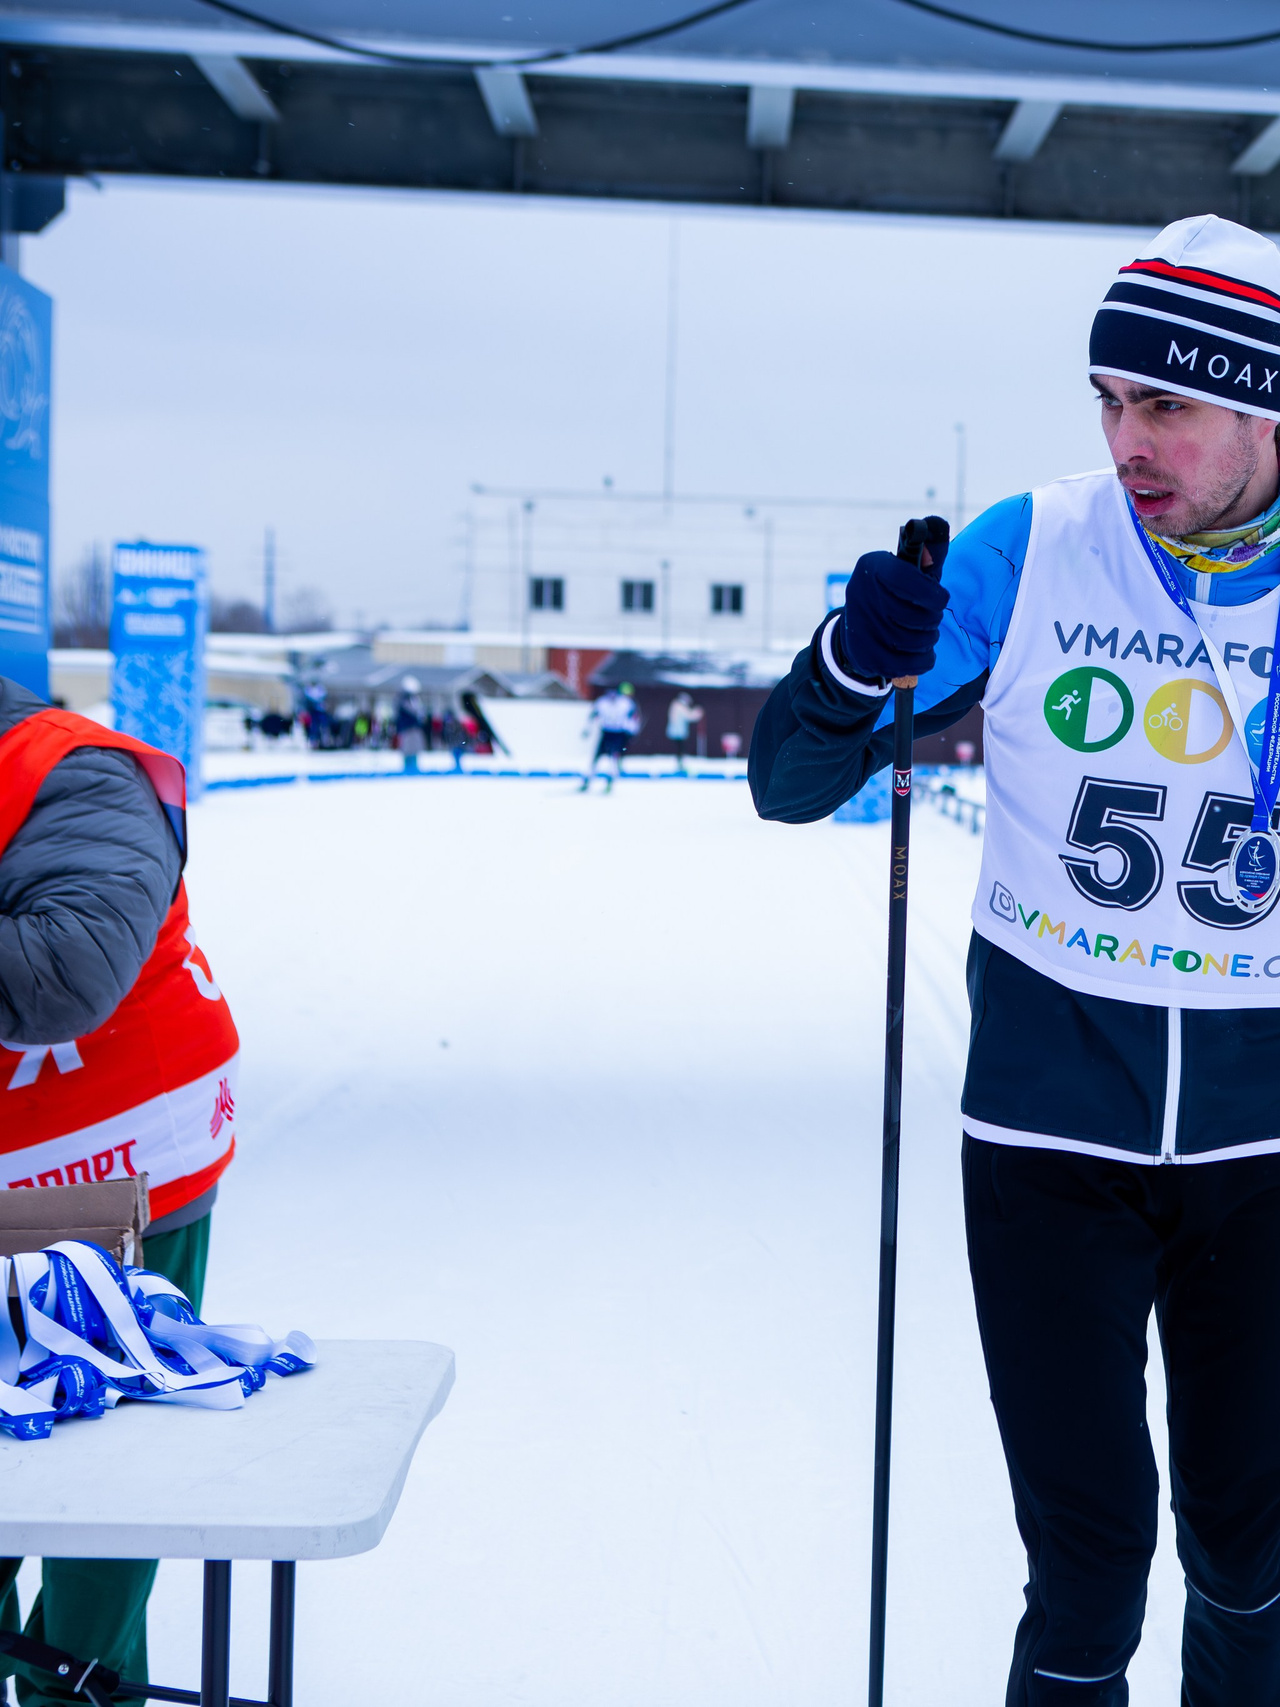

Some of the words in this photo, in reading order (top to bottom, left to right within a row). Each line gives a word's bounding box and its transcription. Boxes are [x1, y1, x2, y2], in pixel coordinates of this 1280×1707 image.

[1166, 340, 1279, 394] MOAX
[1271, 693, 1280, 734] РОССИЙСКОЙ
[1266, 735, 1275, 772] ФЕДЕРАЦИИ
[893, 846, 907, 900] MOAX
